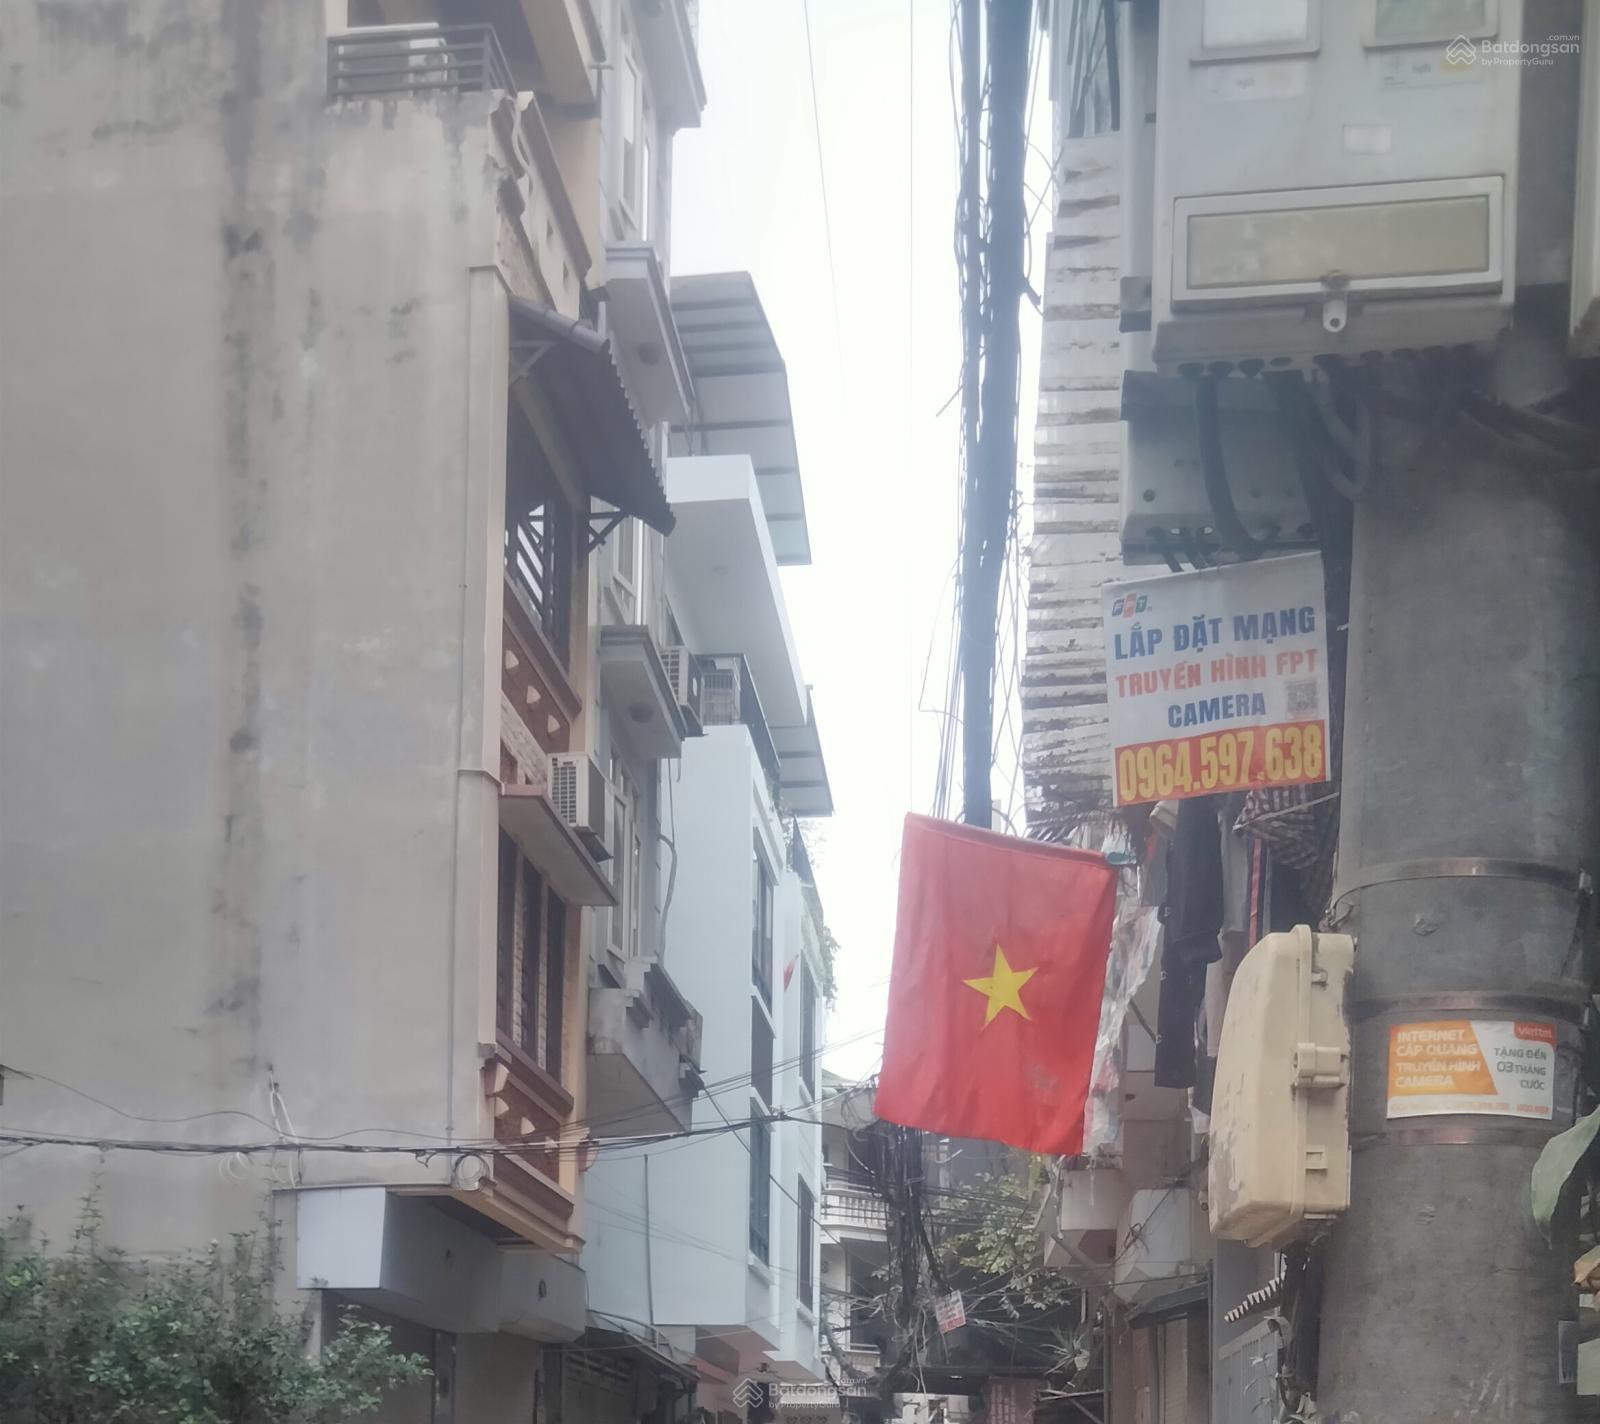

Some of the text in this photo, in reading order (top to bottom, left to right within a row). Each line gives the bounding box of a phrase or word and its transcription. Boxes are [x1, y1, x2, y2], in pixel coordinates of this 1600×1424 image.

[1114, 606, 1317, 661] LẮP ĐẶT MẠNG
[1116, 648, 1318, 698] TRUYỀN HÌNH FPT
[1167, 692, 1267, 728] CAMERA
[1118, 724, 1322, 802] 0964.597.638
[1397, 1028, 1466, 1042] INTERNET
[1396, 1043, 1478, 1057] CÁP QUANG
[1496, 1061, 1514, 1073] 03
[1395, 1073, 1454, 1088] CAMERA
